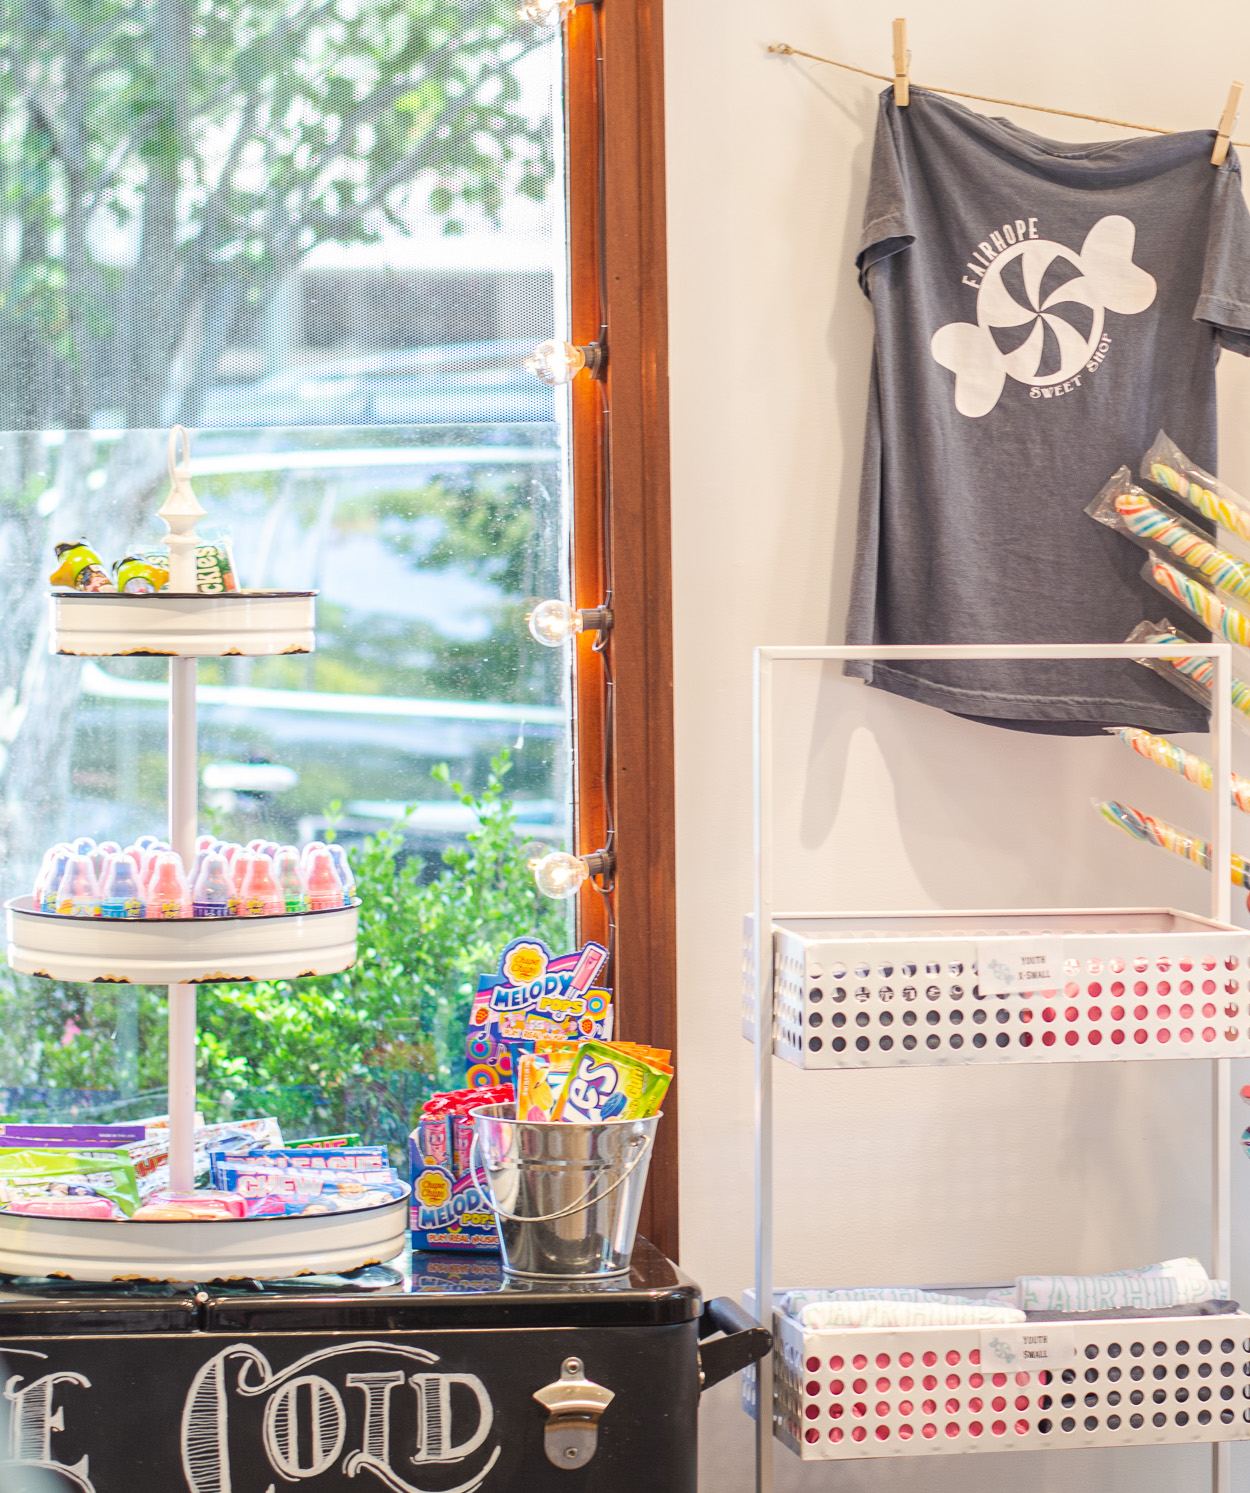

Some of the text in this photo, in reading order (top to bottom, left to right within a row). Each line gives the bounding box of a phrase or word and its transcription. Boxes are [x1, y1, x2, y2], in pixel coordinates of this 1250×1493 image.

[962, 217, 1040, 290] FAIRHOPE
[1029, 332, 1113, 399] SWEET SHOP
[197, 545, 223, 592] ckles
[494, 973, 574, 1008] MELODY
[540, 997, 584, 1013] POPS
[237, 1173, 324, 1199] CHEW
